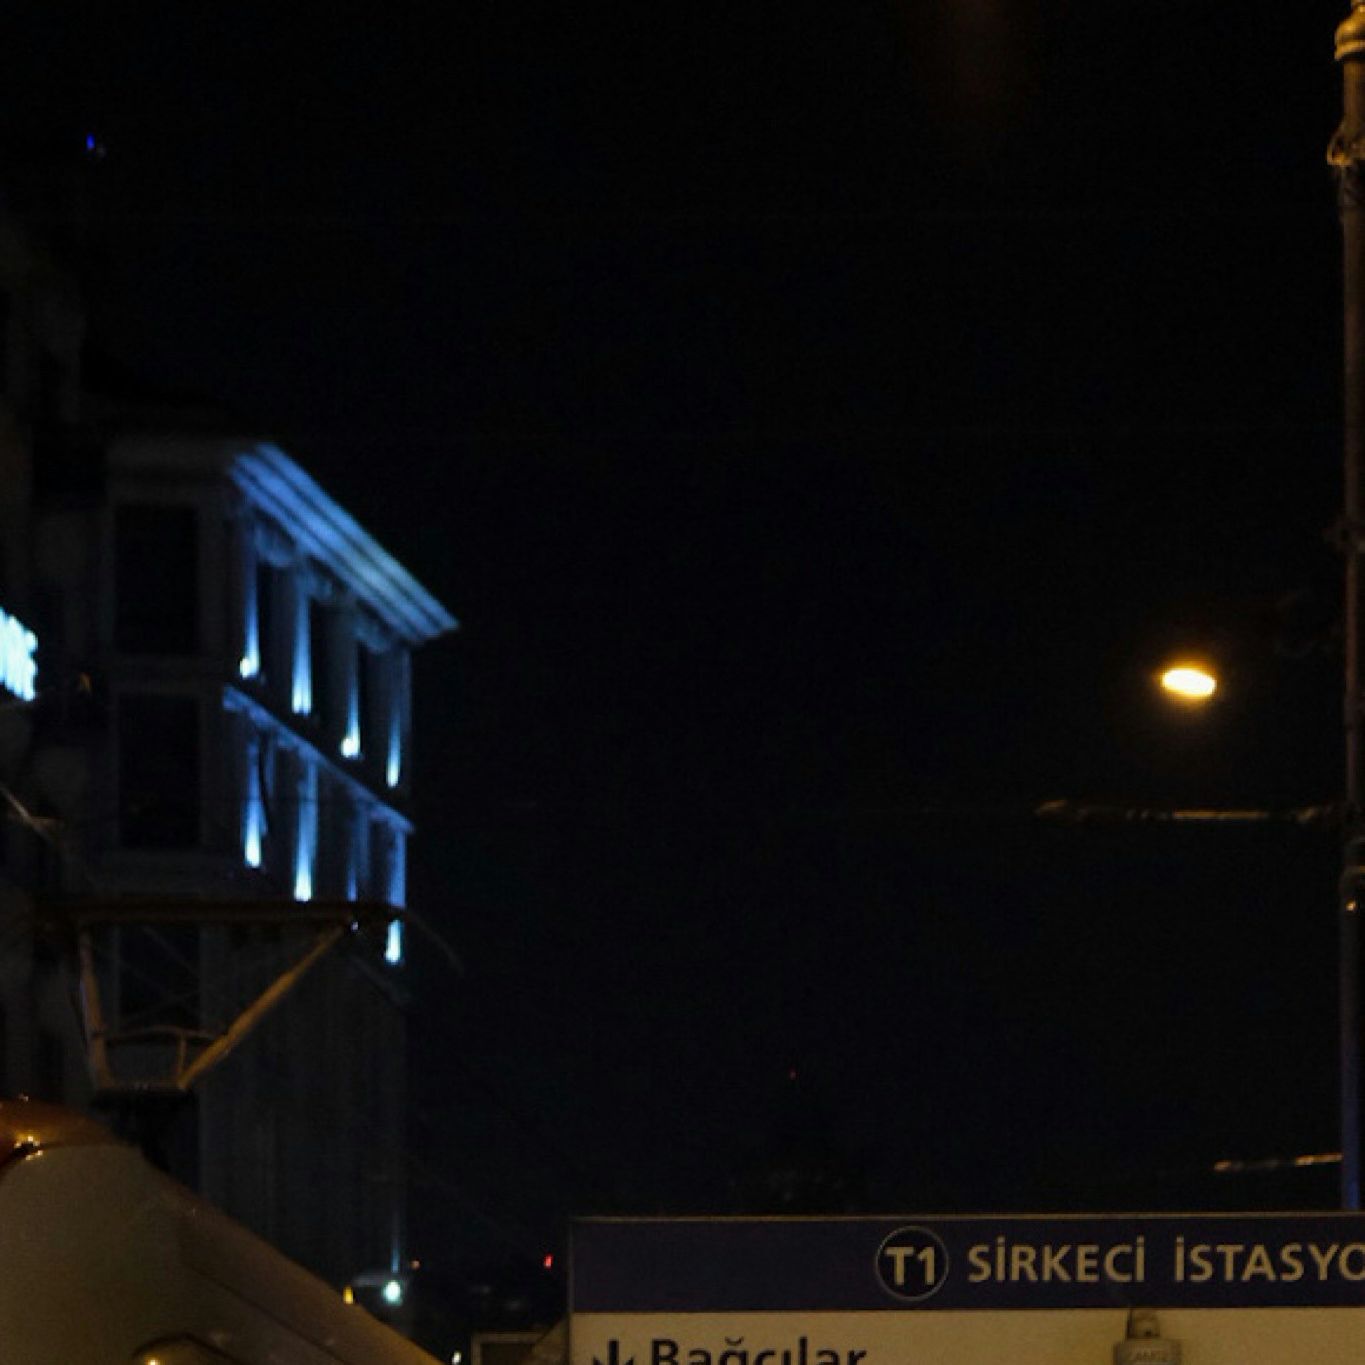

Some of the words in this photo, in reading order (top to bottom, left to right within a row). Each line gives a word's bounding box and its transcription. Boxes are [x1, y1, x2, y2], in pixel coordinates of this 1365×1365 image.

[885, 1246, 935, 1286] T1
[967, 1235, 1145, 1283] SİRKECİ
[1175, 1235, 1365, 1283] İSTASYO
